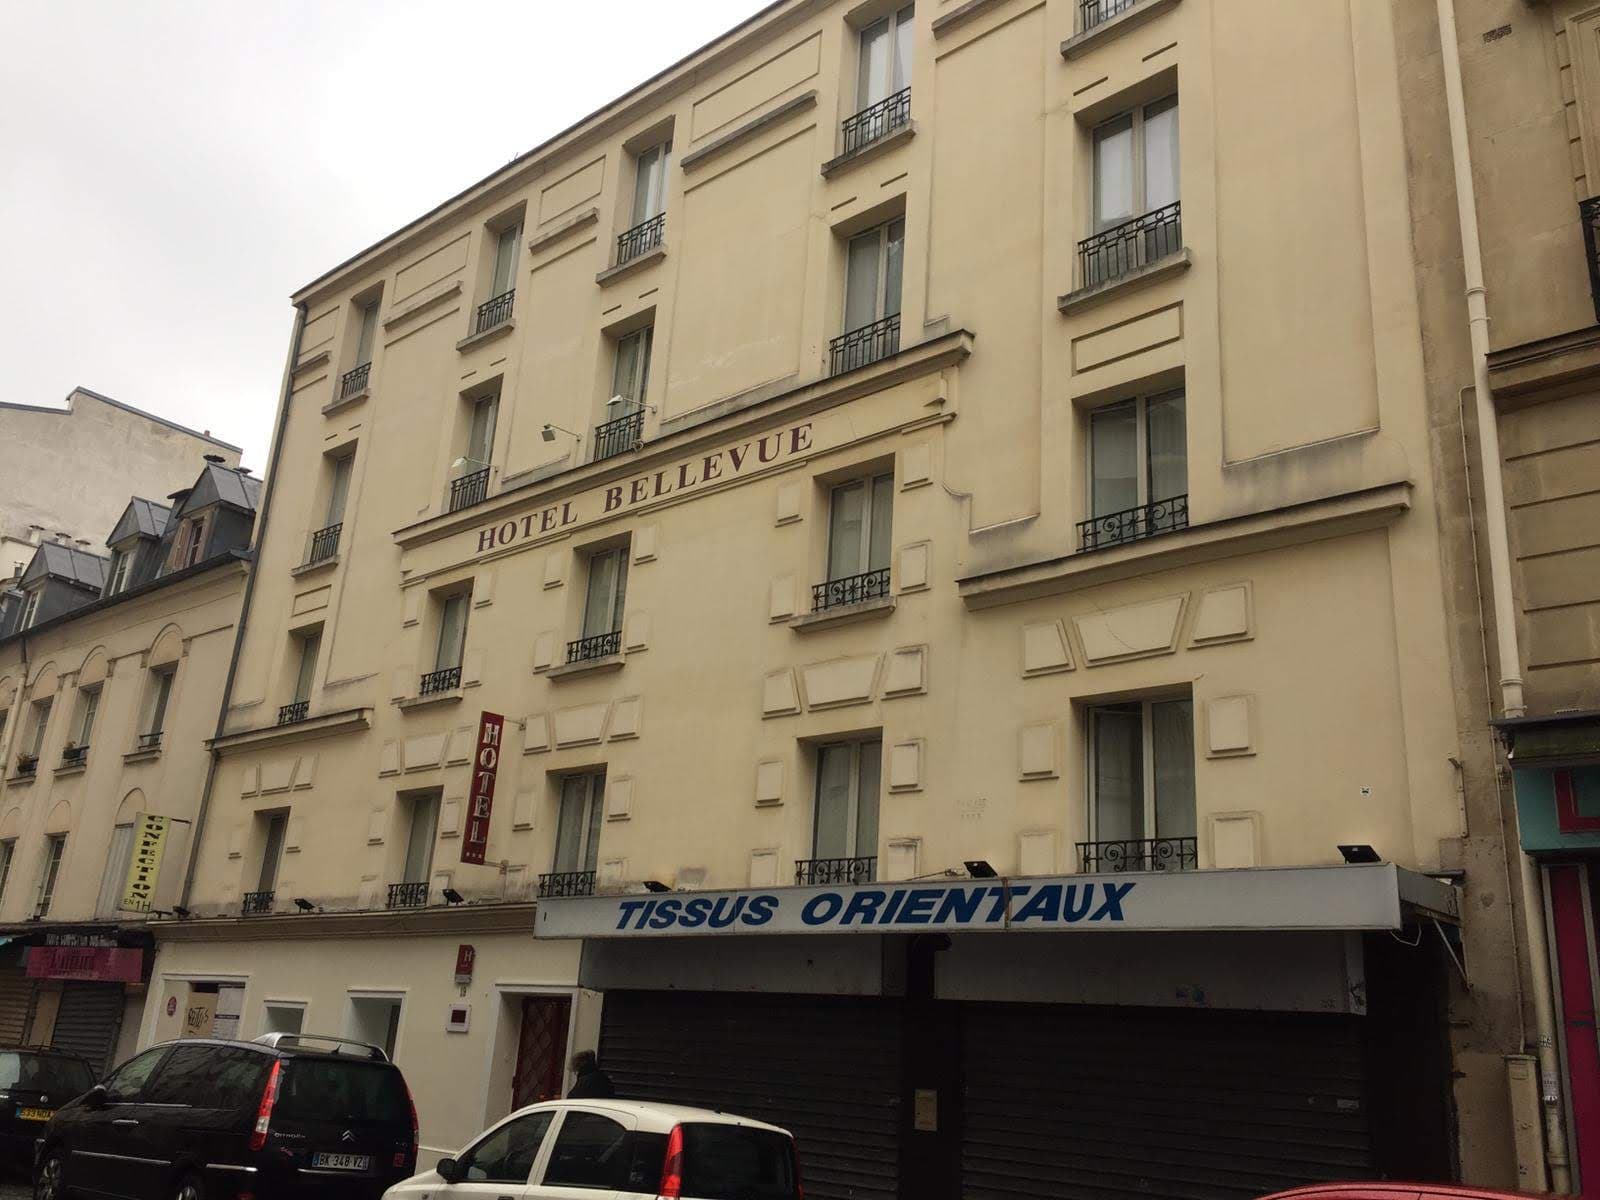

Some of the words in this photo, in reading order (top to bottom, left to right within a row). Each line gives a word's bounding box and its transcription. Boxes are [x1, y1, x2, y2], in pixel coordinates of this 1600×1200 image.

[476, 501, 578, 553] HOTEL
[602, 422, 815, 514] BELLEVUE
[470, 722, 500, 843] HOTEL
[130, 815, 163, 899] CONFECTION
[615, 895, 779, 930] TISSUS
[799, 882, 1136, 926] ORIENTAUX
[333, 1155, 350, 1167] 348
